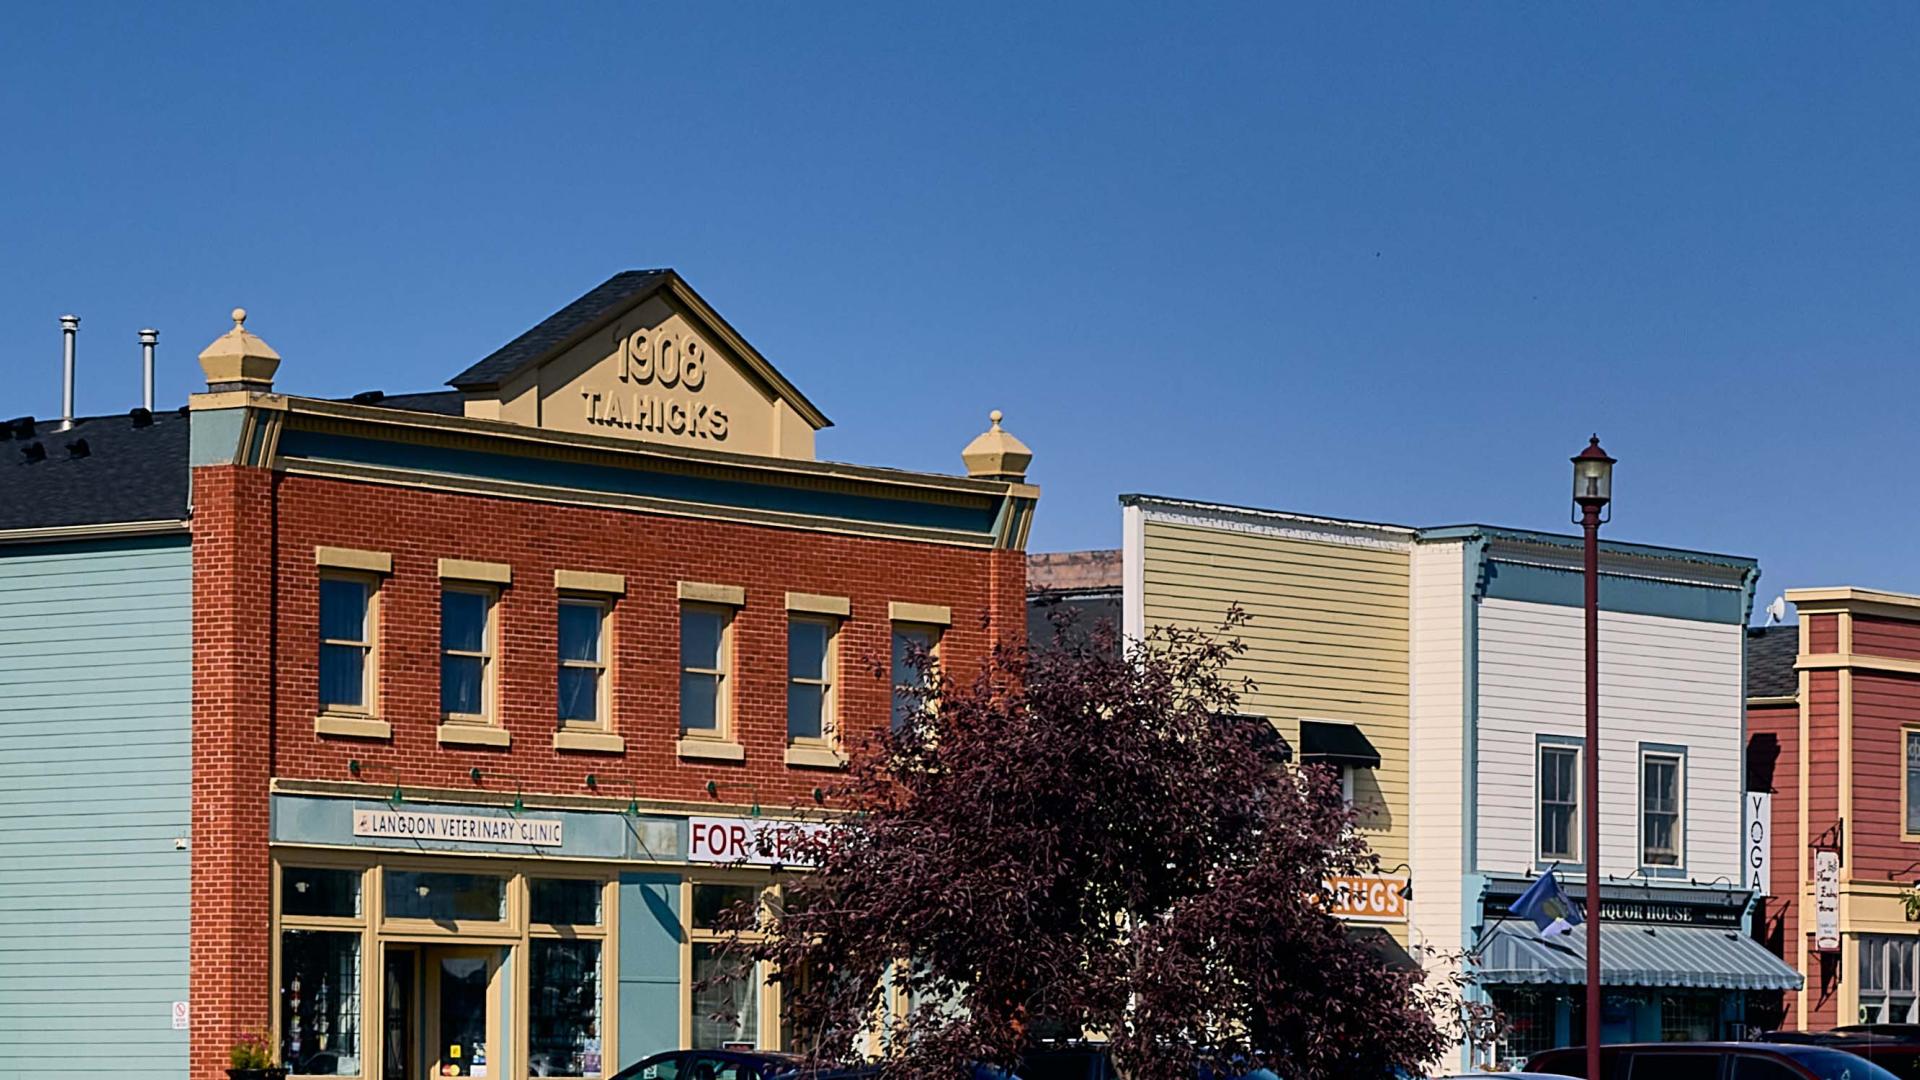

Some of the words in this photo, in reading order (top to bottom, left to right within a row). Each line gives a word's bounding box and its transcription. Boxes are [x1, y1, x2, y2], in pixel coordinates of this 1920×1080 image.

[618, 328, 705, 392] 1908
[372, 814, 436, 835] LANGDON
[441, 818, 515, 840] VETERINARY
[520, 823, 560, 842] CLINIC
[692, 823, 747, 857] FOR
[1750, 796, 1764, 893] YOGA
[1598, 903, 1643, 920] IQUOR
[1647, 905, 1692, 922] HOUSE
